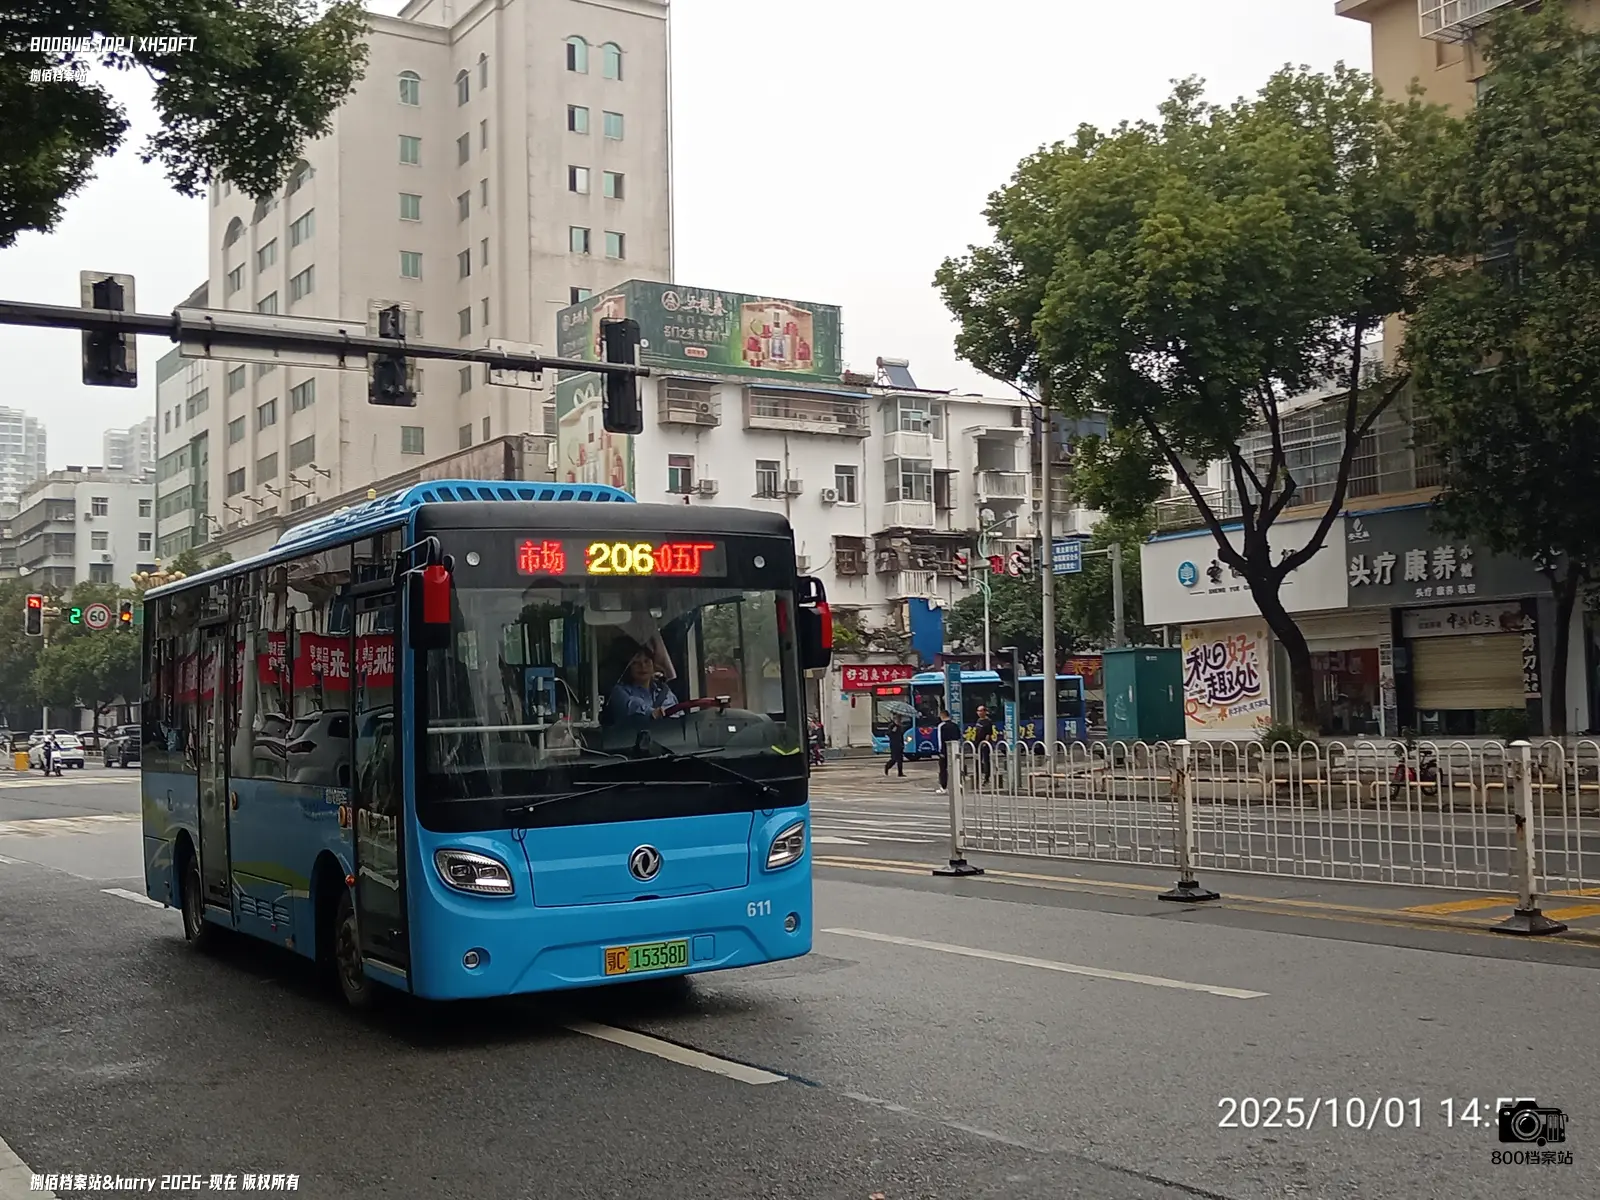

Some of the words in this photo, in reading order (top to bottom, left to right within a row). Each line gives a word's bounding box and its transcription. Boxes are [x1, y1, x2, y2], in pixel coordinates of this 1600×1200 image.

[519, 540, 565, 574] 市场
[588, 541, 655, 574] 206
[1348, 550, 1396, 587] 头疗
[1404, 544, 1457, 582] 康养
[90, 611, 106, 622] 60
[746, 899, 771, 917] 611
[634, 944, 686, 968] 15358D
